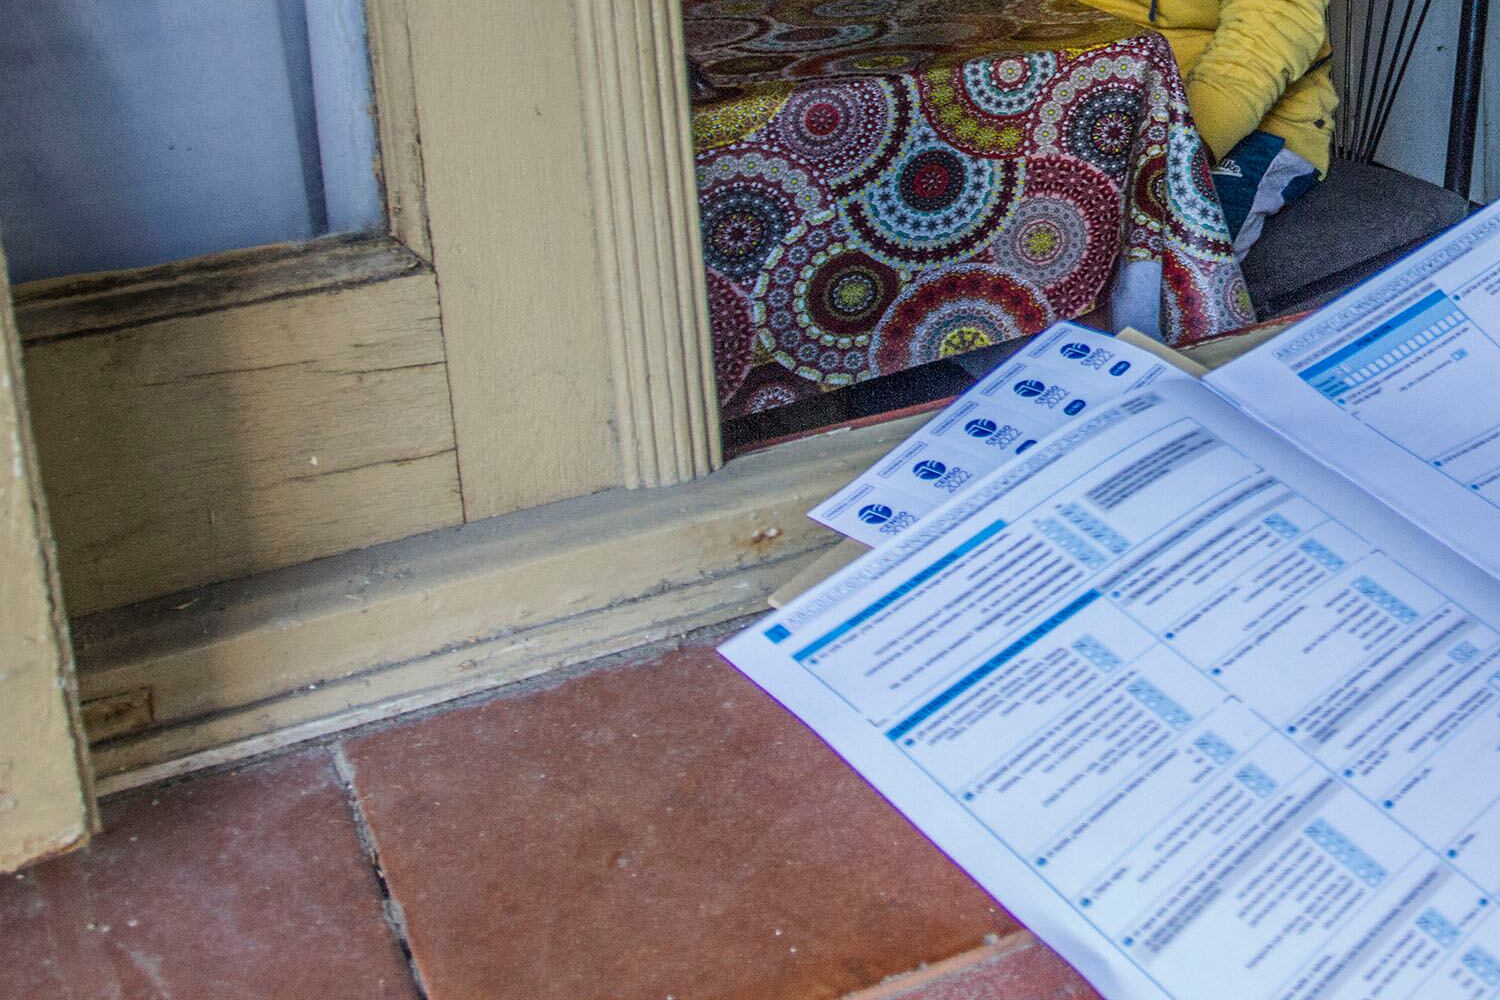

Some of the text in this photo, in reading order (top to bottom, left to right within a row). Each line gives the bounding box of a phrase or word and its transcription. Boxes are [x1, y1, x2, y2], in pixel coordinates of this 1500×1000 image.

[1080, 347, 1104, 367] CENSO
[1089, 352, 1116, 370] 2022
[1034, 385, 1058, 405] CENSO
[1044, 390, 1071, 409] 2022
[985, 425, 1011, 447] CENSO
[996, 428, 1024, 450] 2022
[934, 466, 961, 489] CENSO
[946, 471, 973, 494] 2022
[879, 511, 908, 534] CENSO
